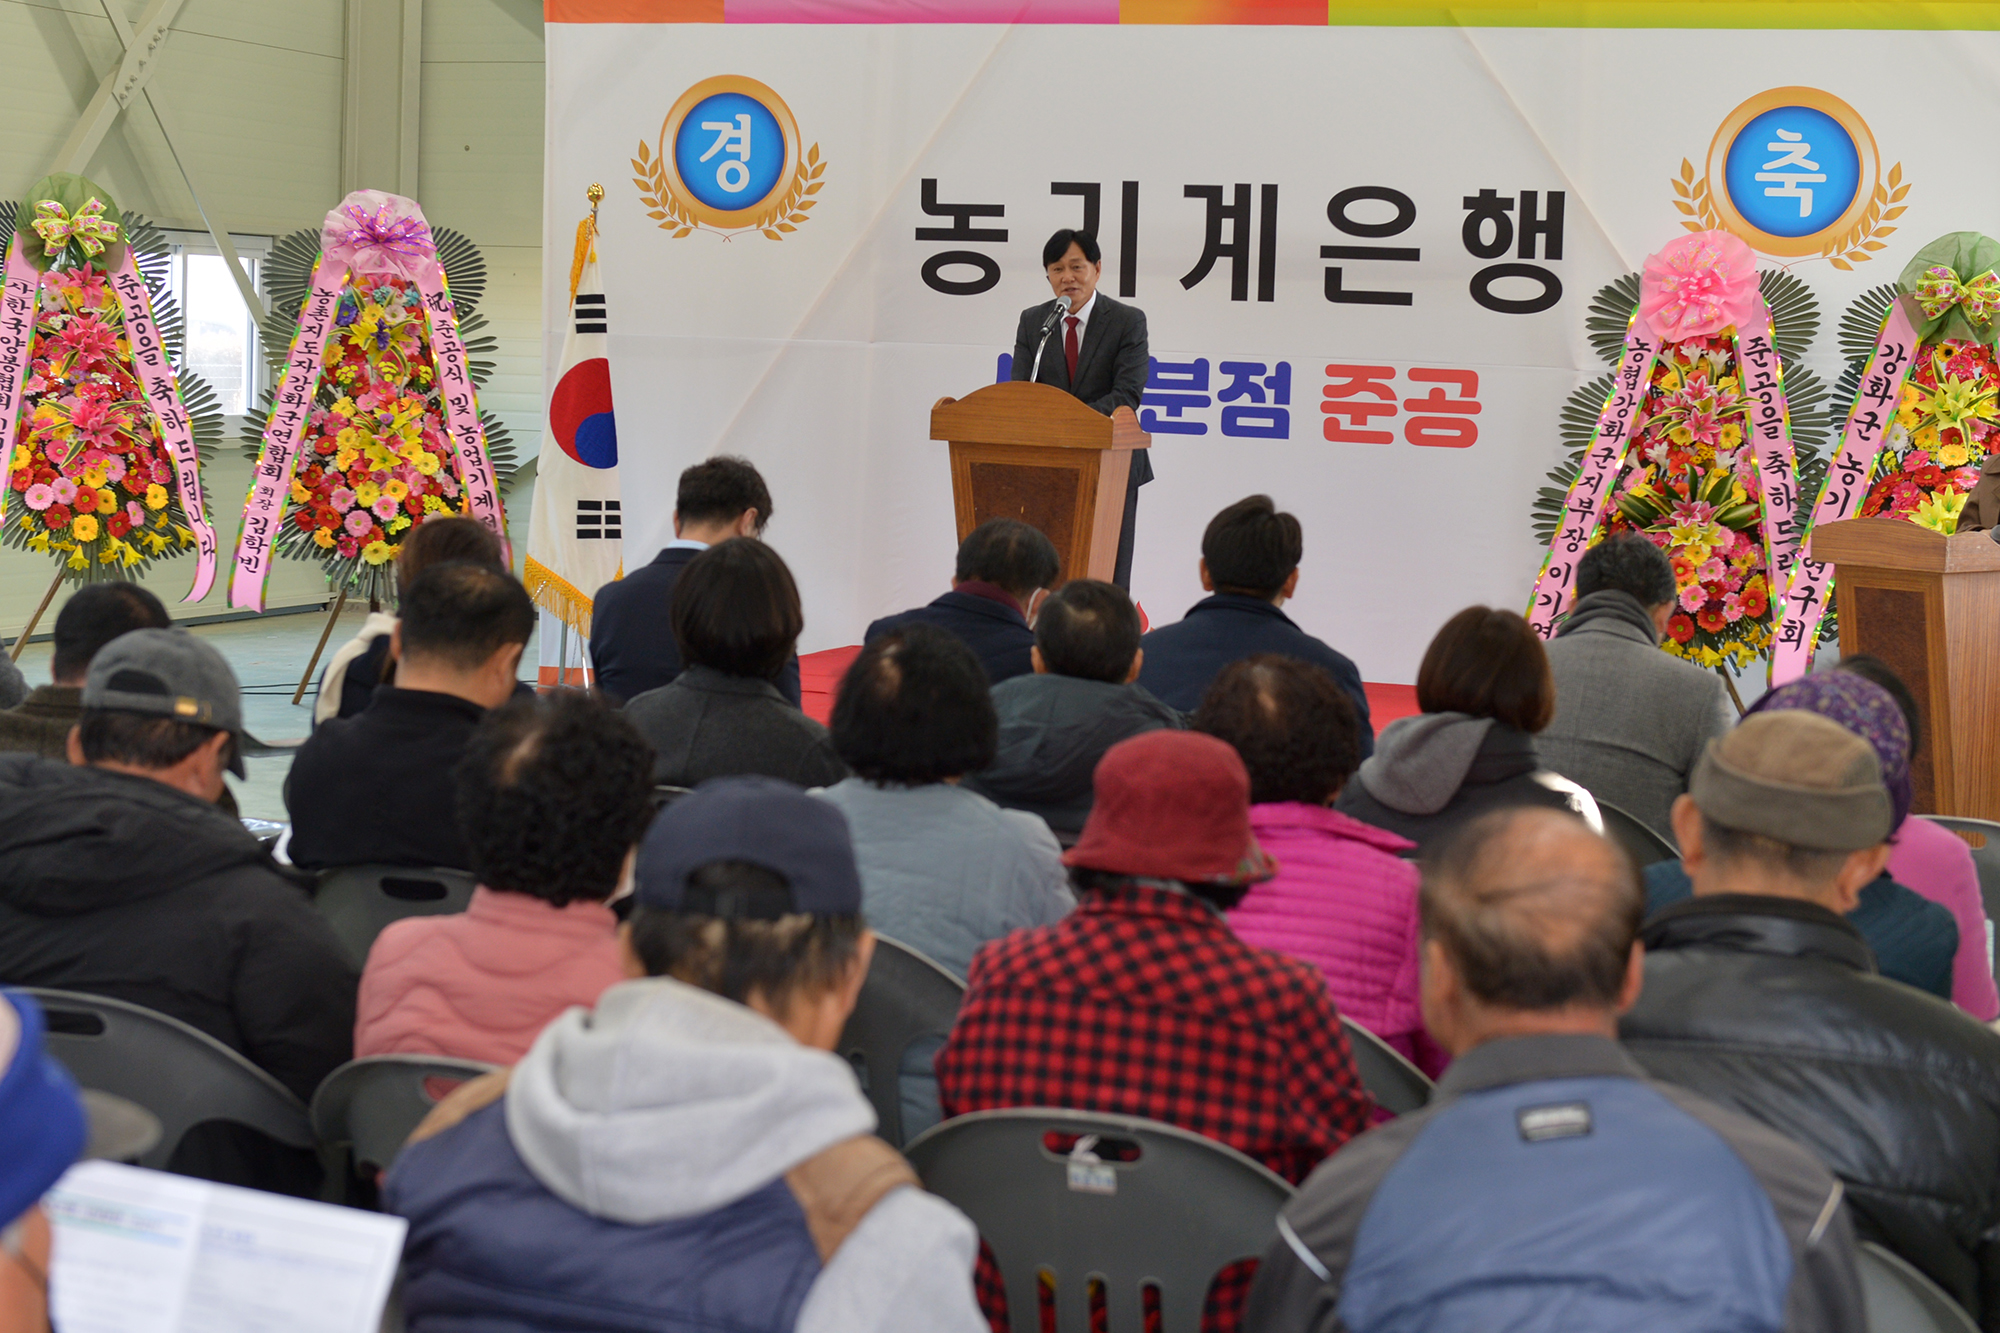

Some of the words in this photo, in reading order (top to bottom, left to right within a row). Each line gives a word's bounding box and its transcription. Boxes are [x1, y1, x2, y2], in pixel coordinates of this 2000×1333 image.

[699, 114, 751, 193] 경
[1754, 128, 1827, 217] 축
[915, 178, 1565, 314] 농기계은행
[117, 273, 159, 366] 준공을
[426, 291, 449, 313] 祝
[435, 319, 464, 385] 준공식
[1743, 336, 1783, 440] 준공을
[1854, 342, 1908, 441] 강화군
[448, 393, 470, 416] 및
[1320, 364, 1482, 449] 준공
[259, 486, 275, 511] 회장
[239, 516, 269, 574] 김학빈
[1778, 452, 1865, 652] 농기연구회
